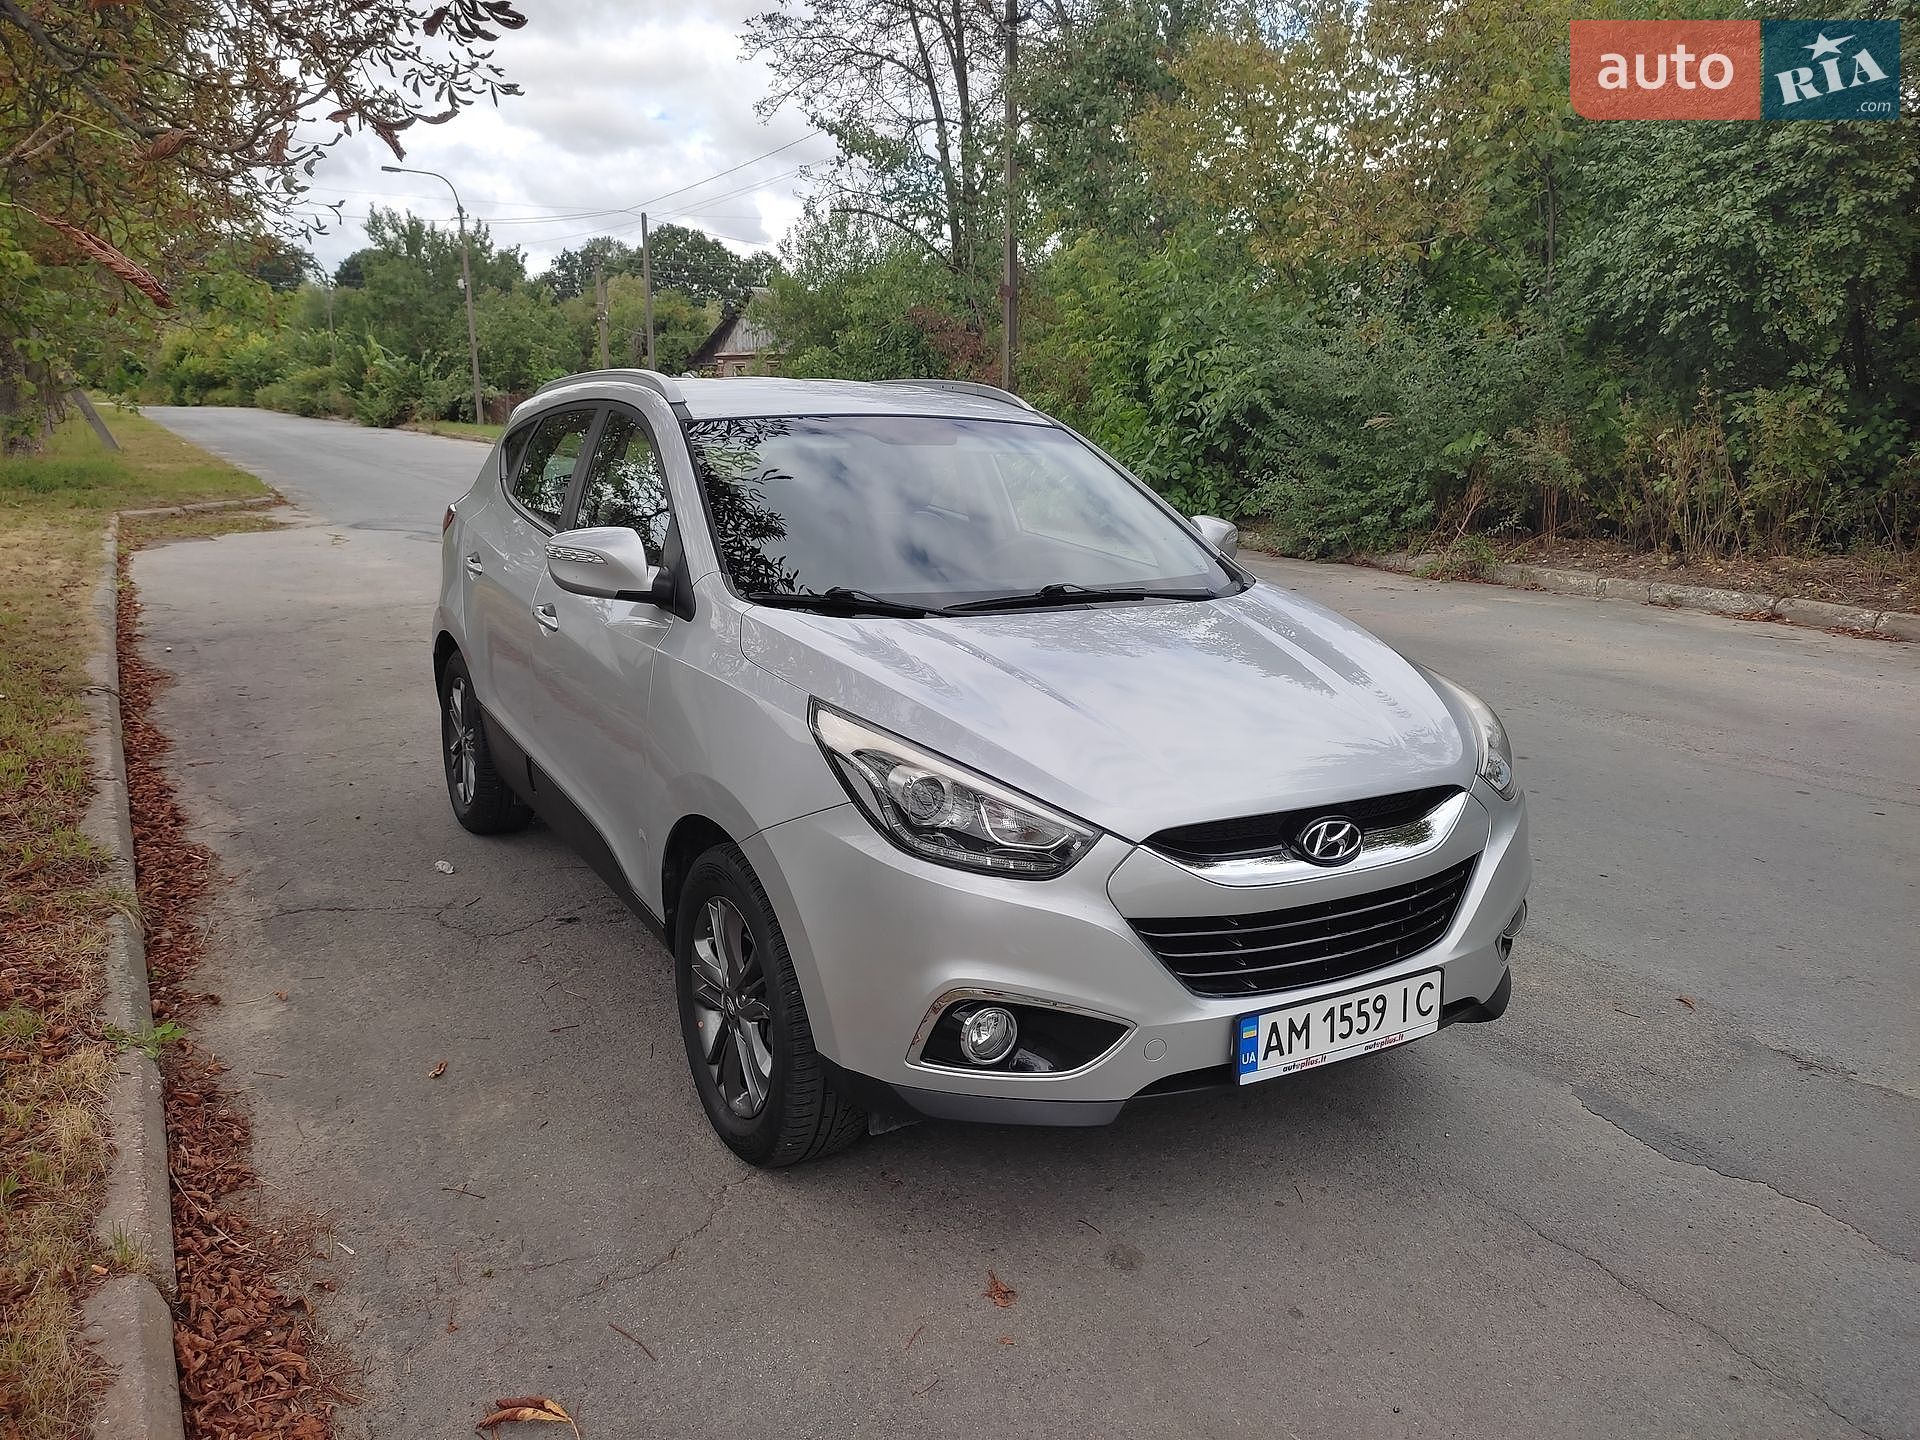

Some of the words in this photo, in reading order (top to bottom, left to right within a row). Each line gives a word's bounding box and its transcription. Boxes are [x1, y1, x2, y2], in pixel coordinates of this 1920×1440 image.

[1262, 1012, 1311, 1060] AM
[1322, 993, 1386, 1043] 1559
[1242, 1051, 1256, 1064] UA
